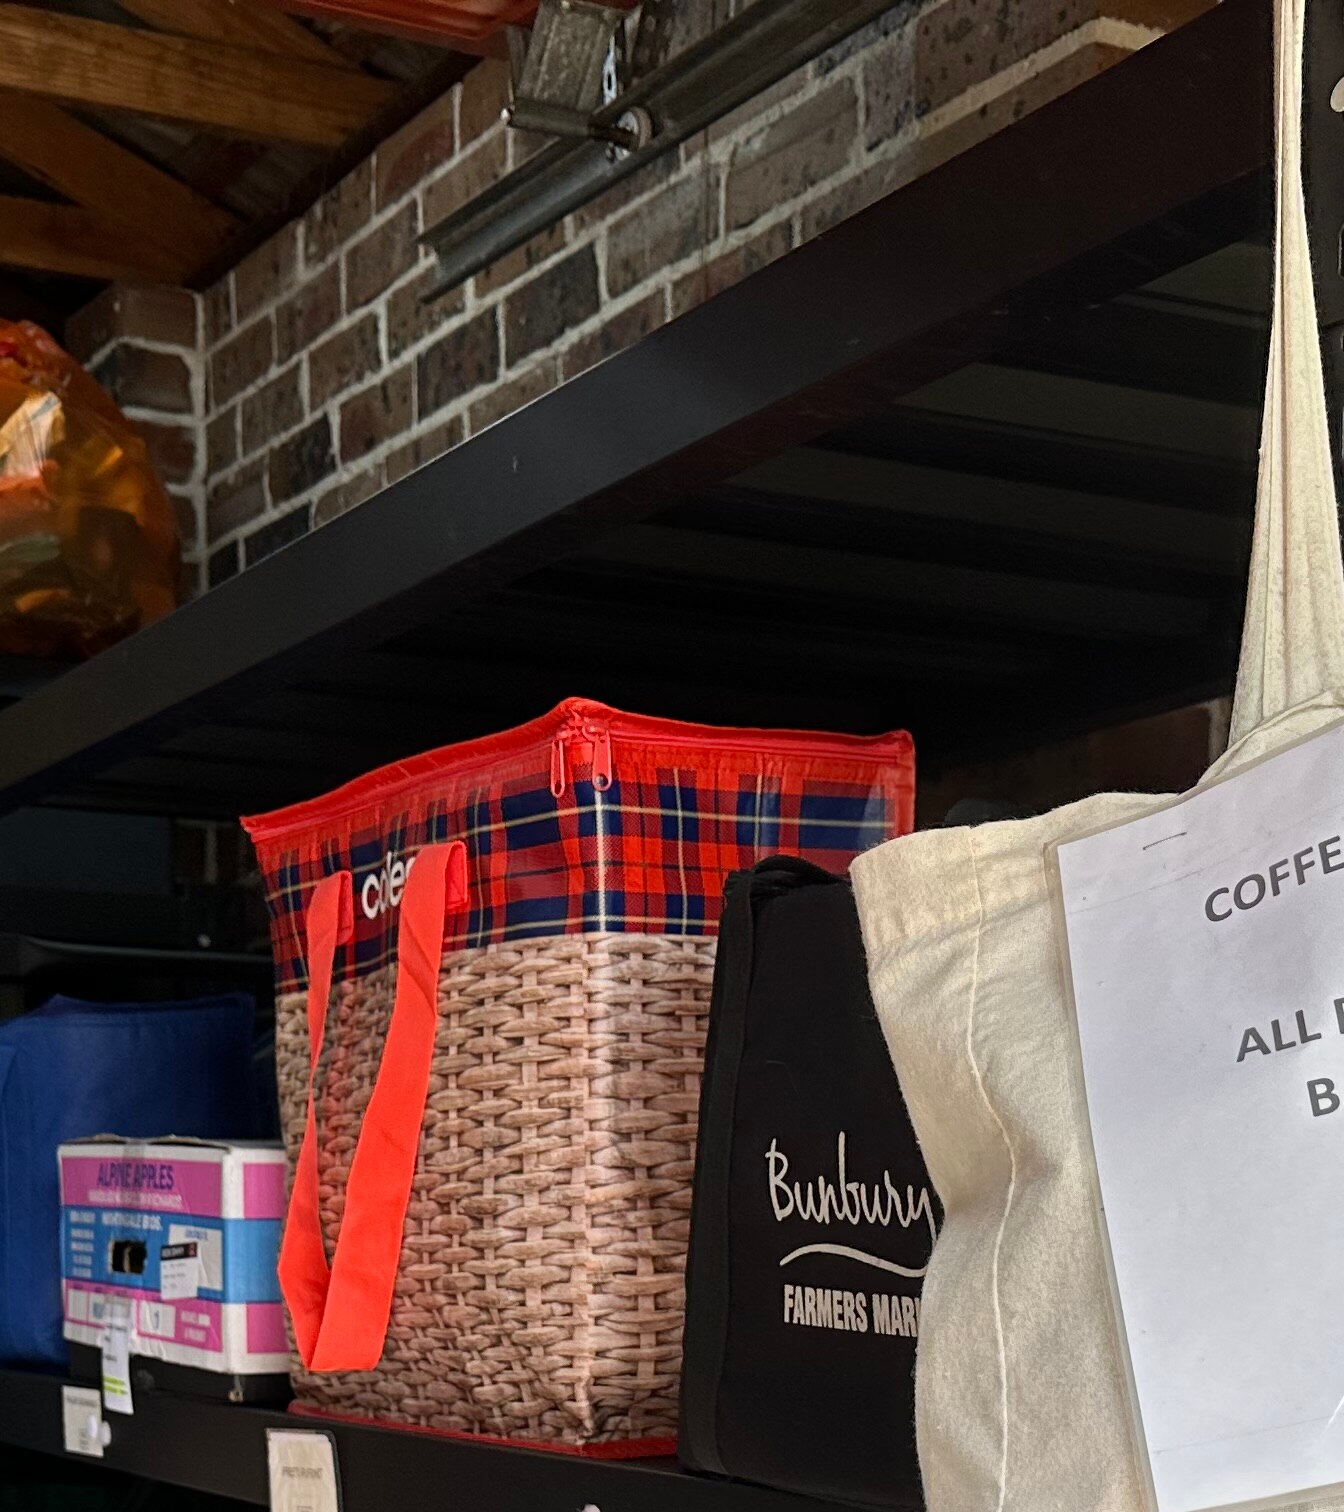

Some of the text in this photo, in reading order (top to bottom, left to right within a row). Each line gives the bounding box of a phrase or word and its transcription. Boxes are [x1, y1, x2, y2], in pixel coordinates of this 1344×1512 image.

[1236, 1008, 1322, 1063] ALL
[134, 1163, 174, 1190] APPLES
[765, 1131, 938, 1247] Bunbury
[783, 1283, 921, 1338] FARMERS MAR
